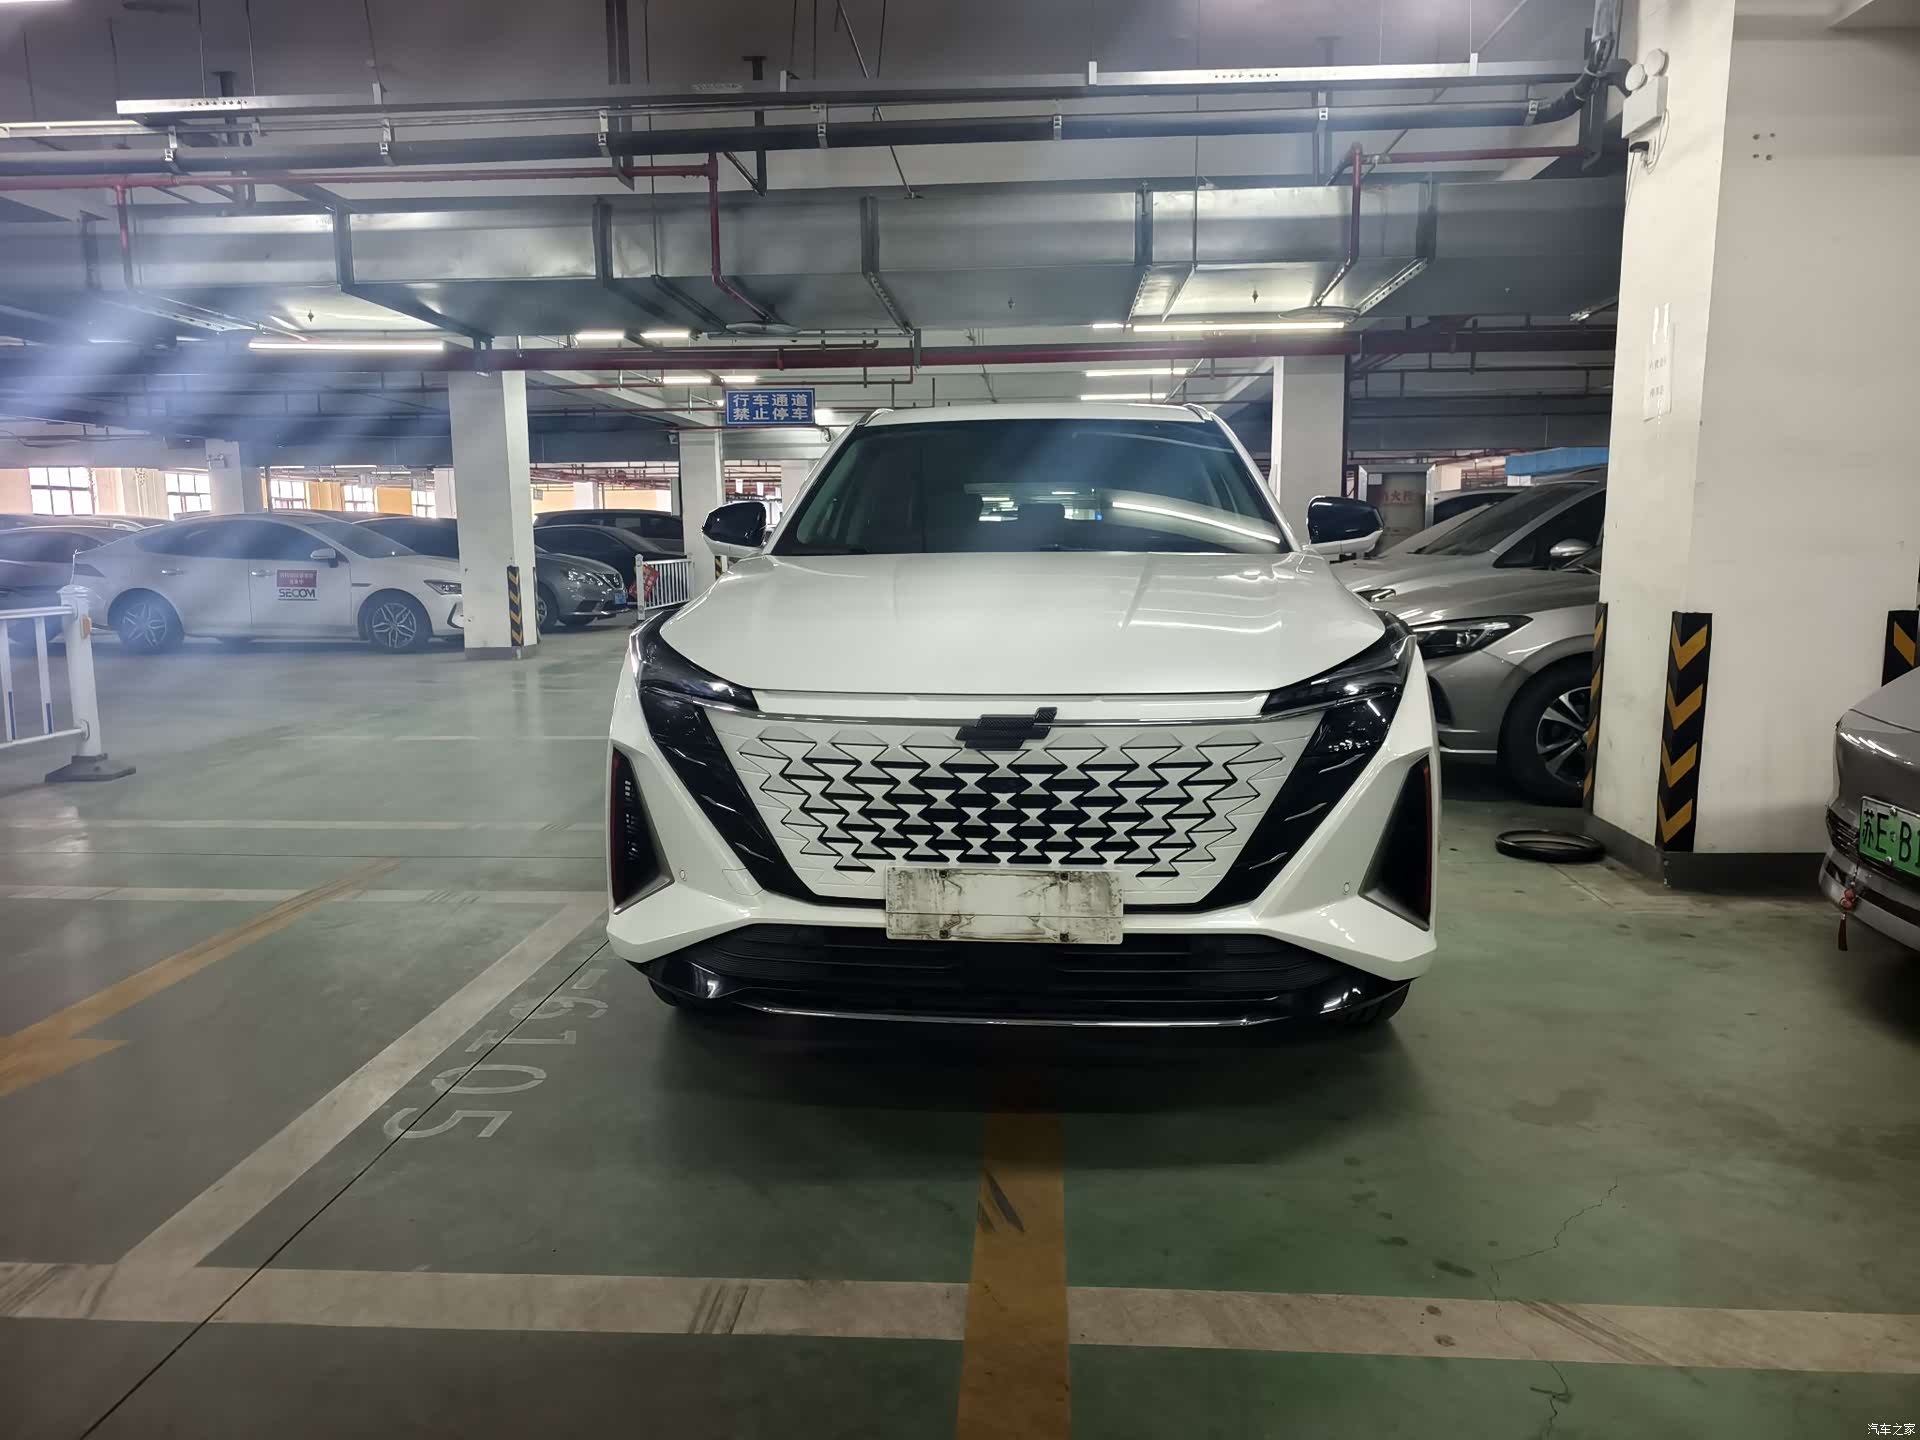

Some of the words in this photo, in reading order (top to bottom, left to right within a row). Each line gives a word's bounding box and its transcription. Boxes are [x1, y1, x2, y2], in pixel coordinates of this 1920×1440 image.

[733, 393, 808, 407] 行车通道
[733, 407, 809, 421] 禁止停车
[278, 588, 316, 598] SECOM
